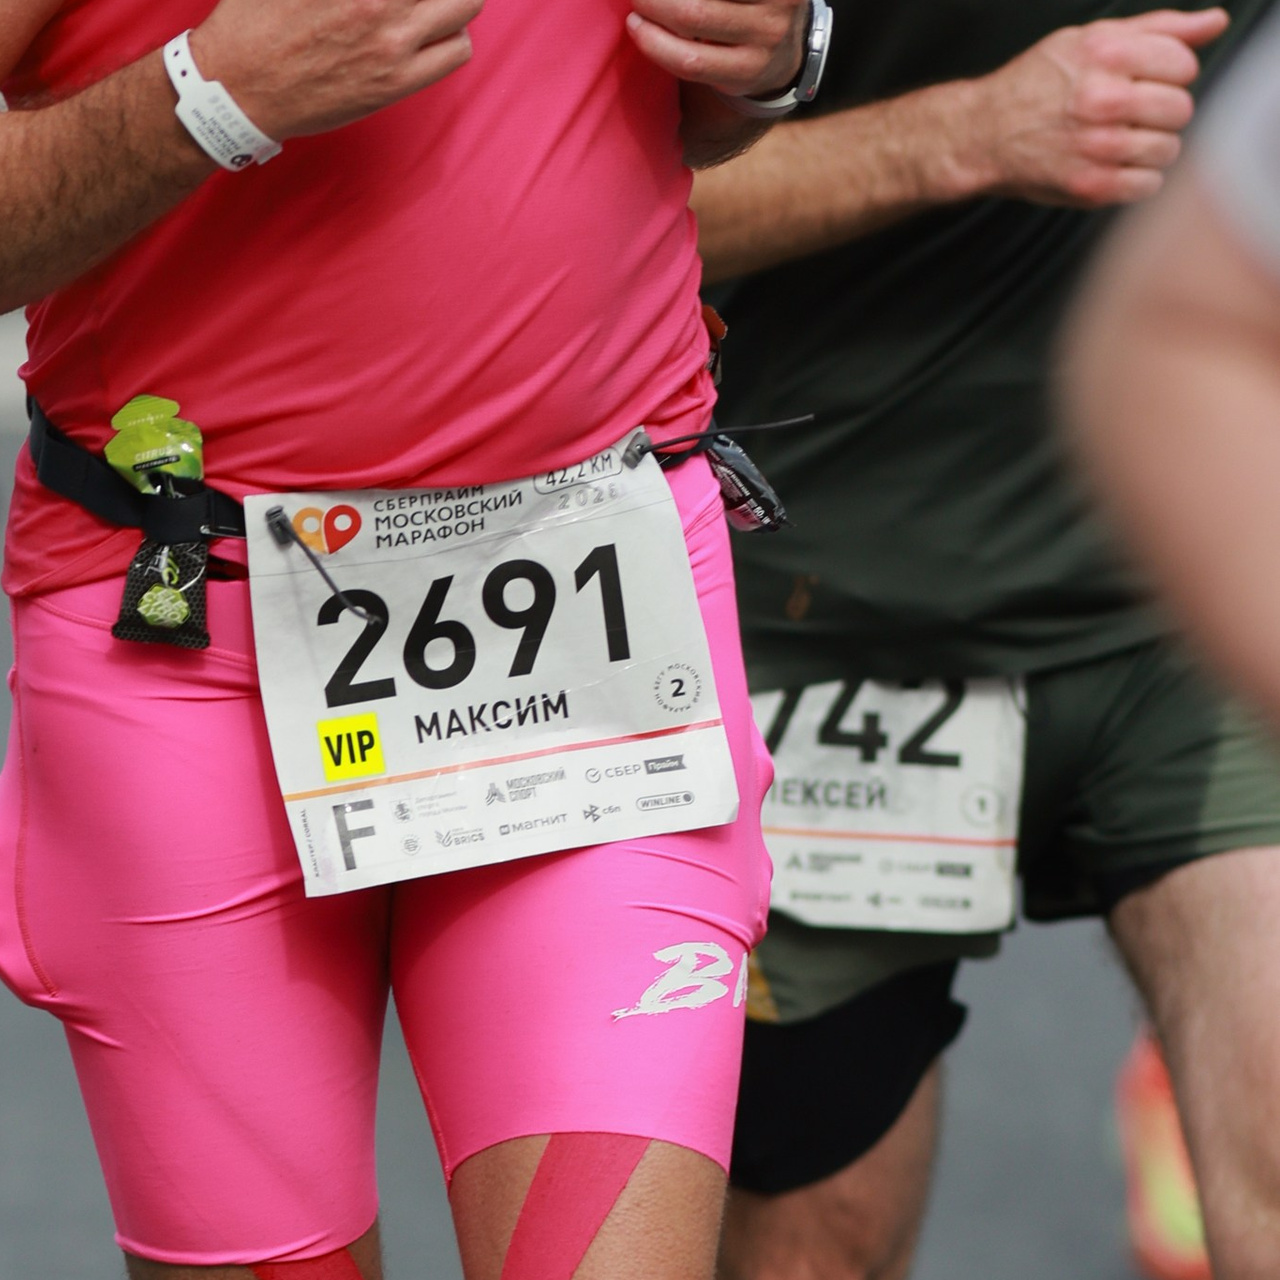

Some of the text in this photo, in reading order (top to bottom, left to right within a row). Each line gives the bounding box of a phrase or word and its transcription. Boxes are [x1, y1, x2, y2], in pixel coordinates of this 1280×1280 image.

[545, 462, 586, 487] 42,2
[374, 491, 523, 531] МОСКОВСКИЙ
[375, 517, 485, 549] МАРАФОН
[317, 543, 631, 708] 2691
[670, 678, 686, 697] 2
[414, 689, 570, 744] МАКСИМ
[324, 729, 376, 767] VIP
[605, 764, 641, 778] СБЕР
[509, 785, 537, 802] СПОРТ
[640, 795, 681, 808] WINLINE
[332, 798, 376, 871] F
[512, 813, 568, 833] магнит
[454, 832, 485, 846] BRICS
